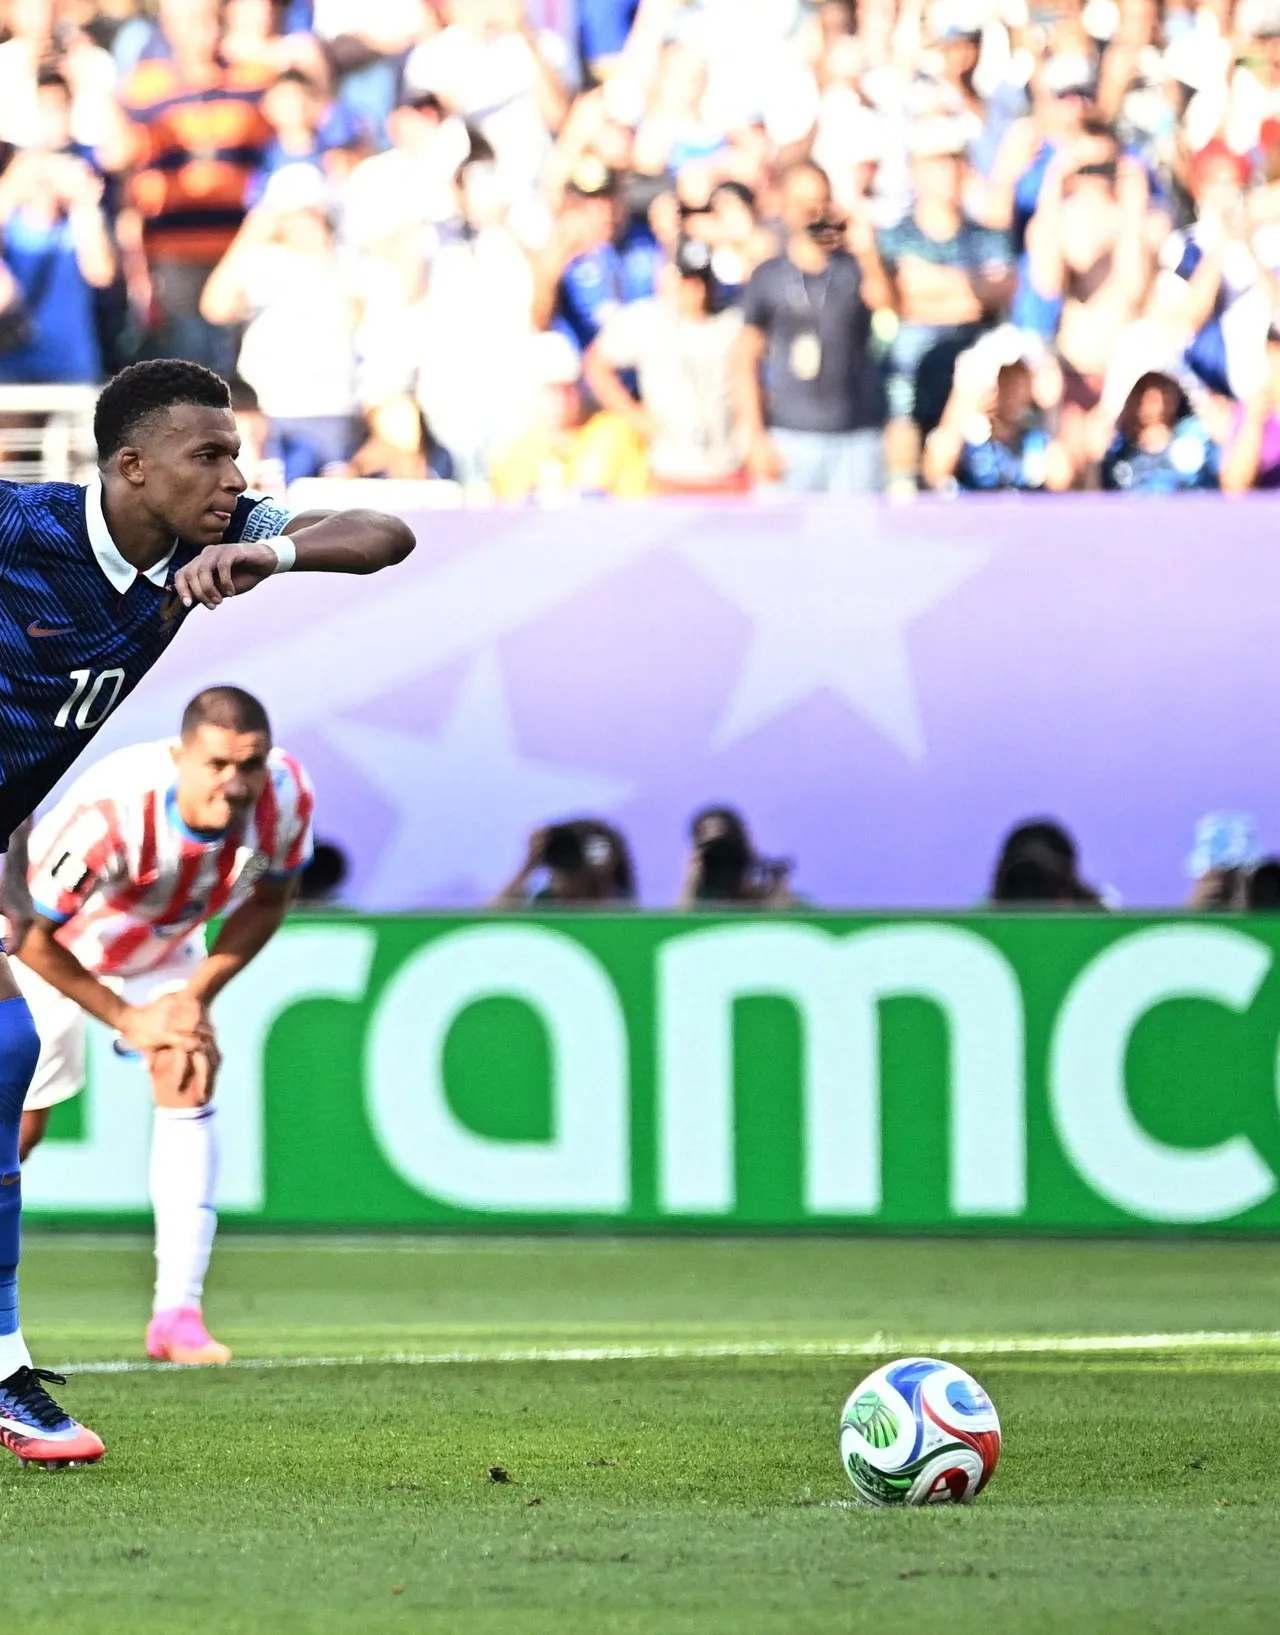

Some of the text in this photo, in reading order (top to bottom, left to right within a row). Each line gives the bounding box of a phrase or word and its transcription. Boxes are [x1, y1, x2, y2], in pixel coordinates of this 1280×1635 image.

[242, 501, 270, 542] FOOTBALL
[251, 507, 280, 543] UNITES
[53, 667, 126, 730] 10
